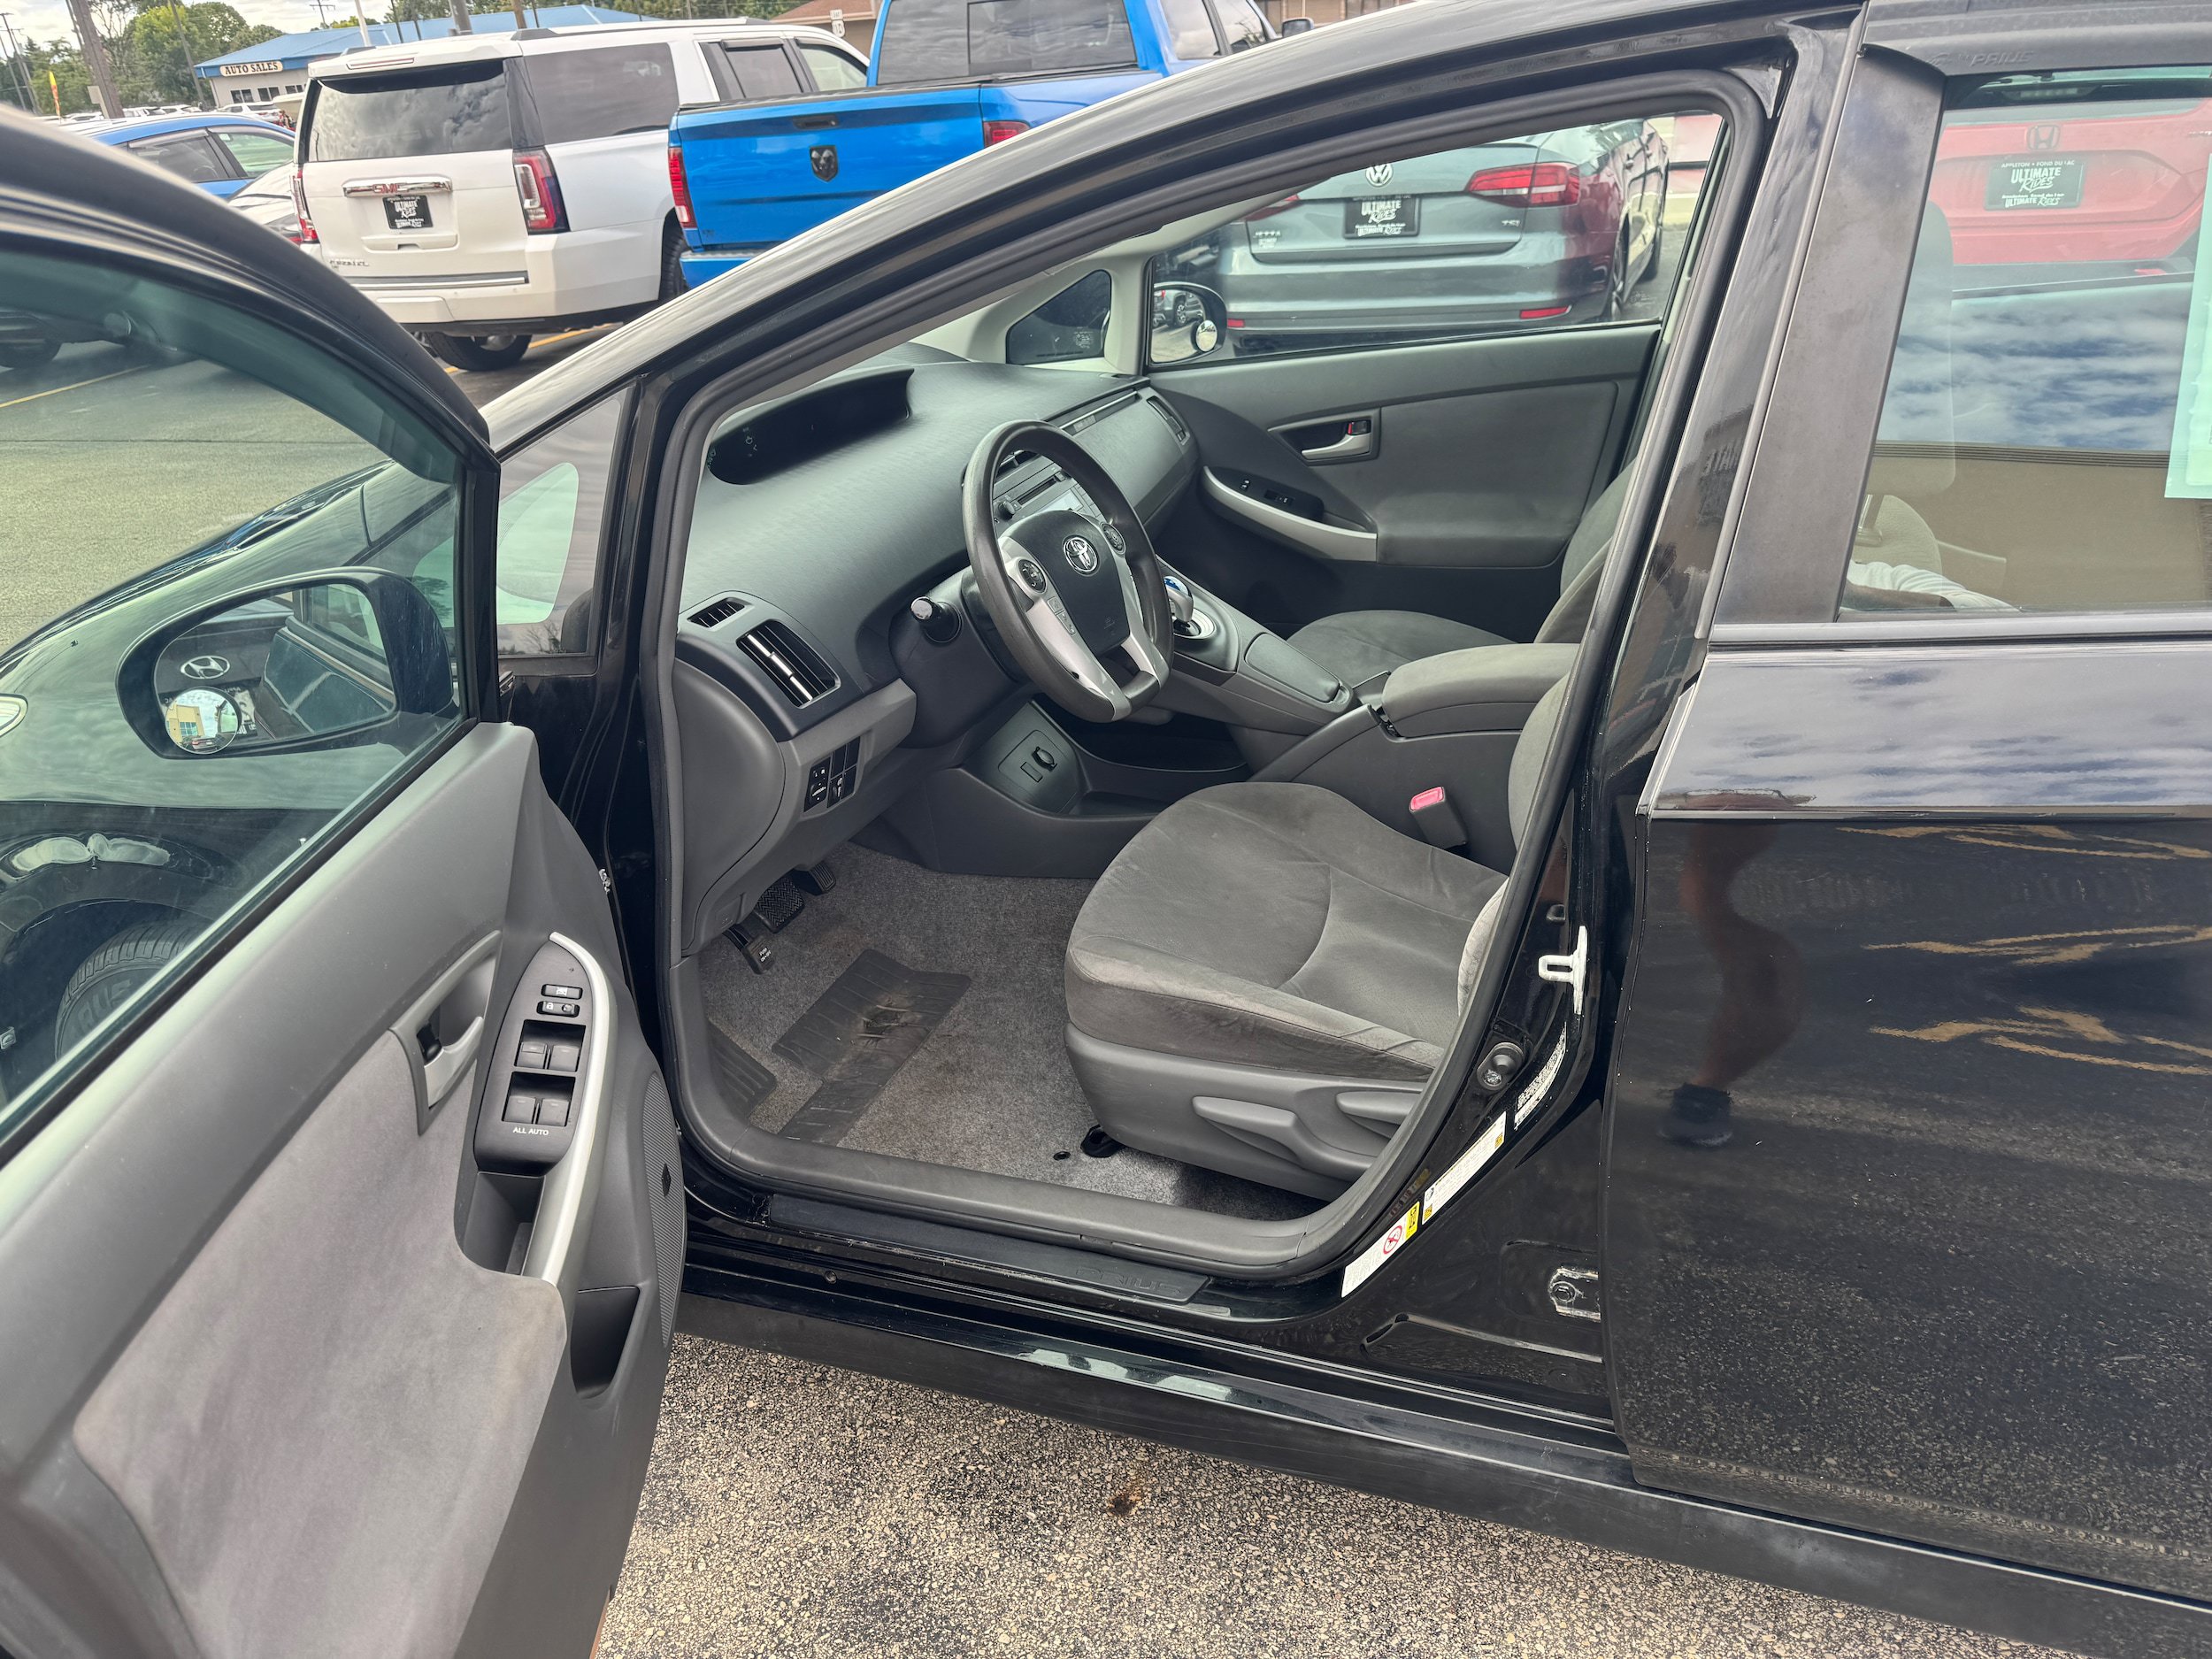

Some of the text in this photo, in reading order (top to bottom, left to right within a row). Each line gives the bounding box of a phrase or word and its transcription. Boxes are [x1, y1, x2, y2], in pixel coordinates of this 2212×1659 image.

[225, 62, 279, 75] AUTO SALES
[2011, 167, 2062, 184] ULTIMATE
[1361, 200, 1402, 216] ULTIMATE
[2005, 197, 2037, 208] ULTIMATE
[528, 1127, 549, 1136] AUTO
